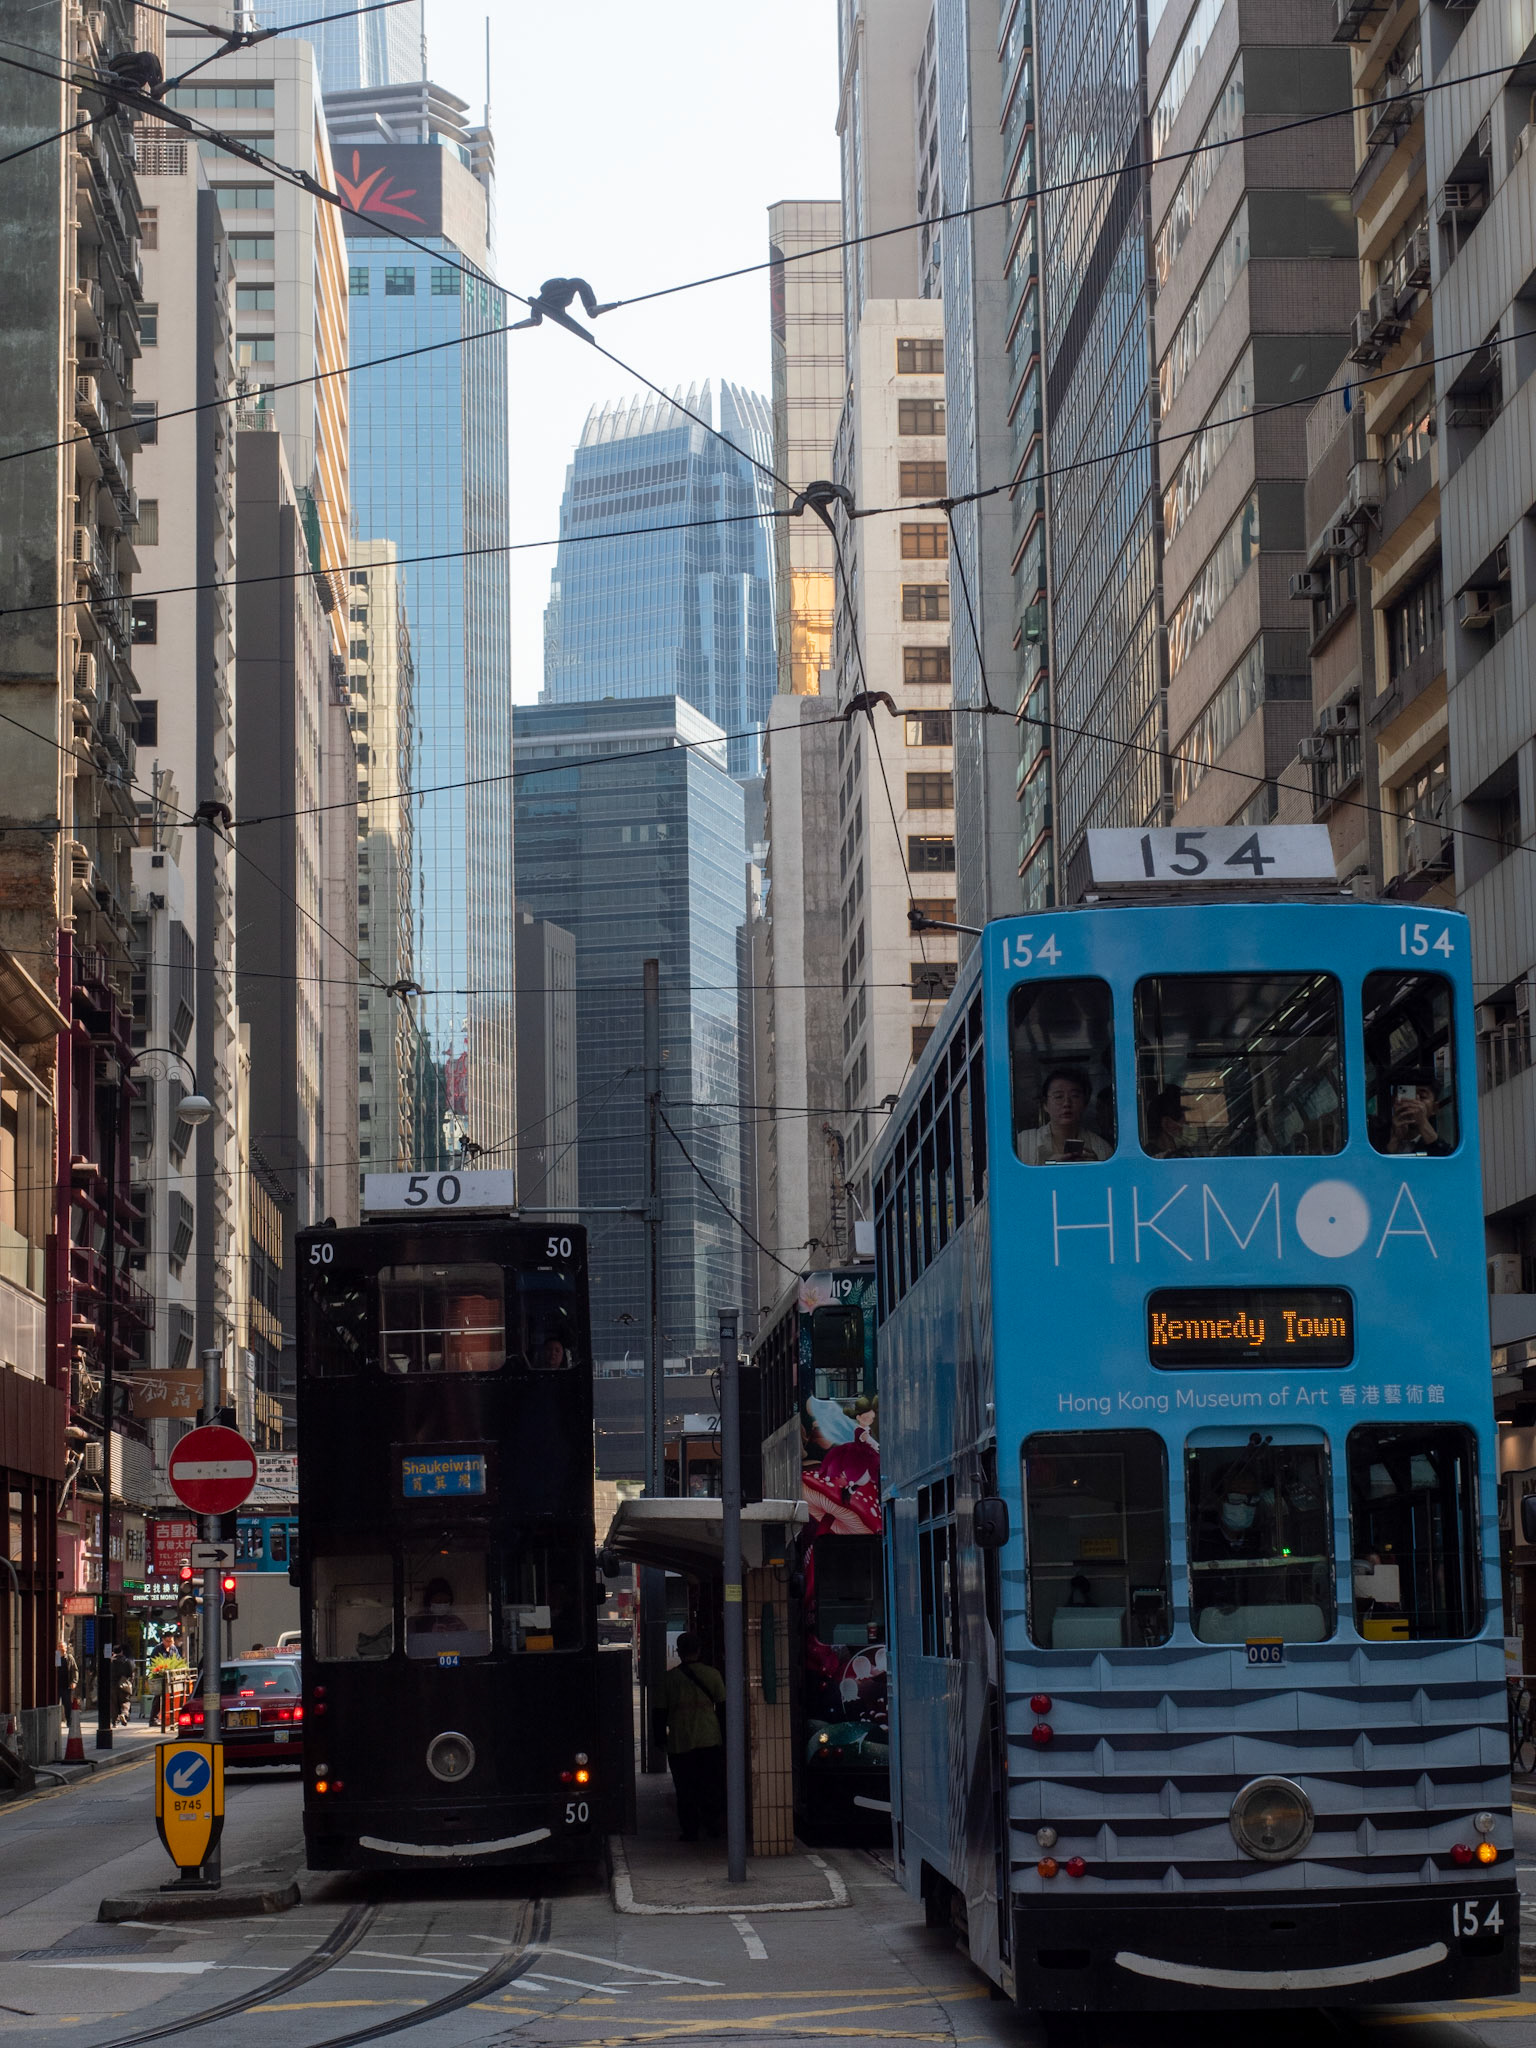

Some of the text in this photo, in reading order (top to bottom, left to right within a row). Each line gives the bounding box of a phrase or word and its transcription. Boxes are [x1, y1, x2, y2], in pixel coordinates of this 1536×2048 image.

[1141, 832, 1275, 876] 154
[1002, 934, 1062, 969] 154
[1401, 923, 1455, 958] 154
[404, 1175, 460, 1206] 50
[309, 1243, 334, 1265] 50
[546, 1237, 572, 1258] 50
[832, 1279, 852, 1297] 119
[1152, 1311, 1346, 1346] Kennedy Town
[1059, 1384, 1445, 1415] Hong Kong Museum of Art 香港藝術館
[403, 1459, 480, 1475] Shaukeiwan
[439, 1655, 459, 1666] 004
[1249, 1646, 1281, 1661] 006
[174, 1799, 202, 1811] B745
[565, 1802, 589, 1823] 50
[1453, 1901, 1504, 1936] 154
